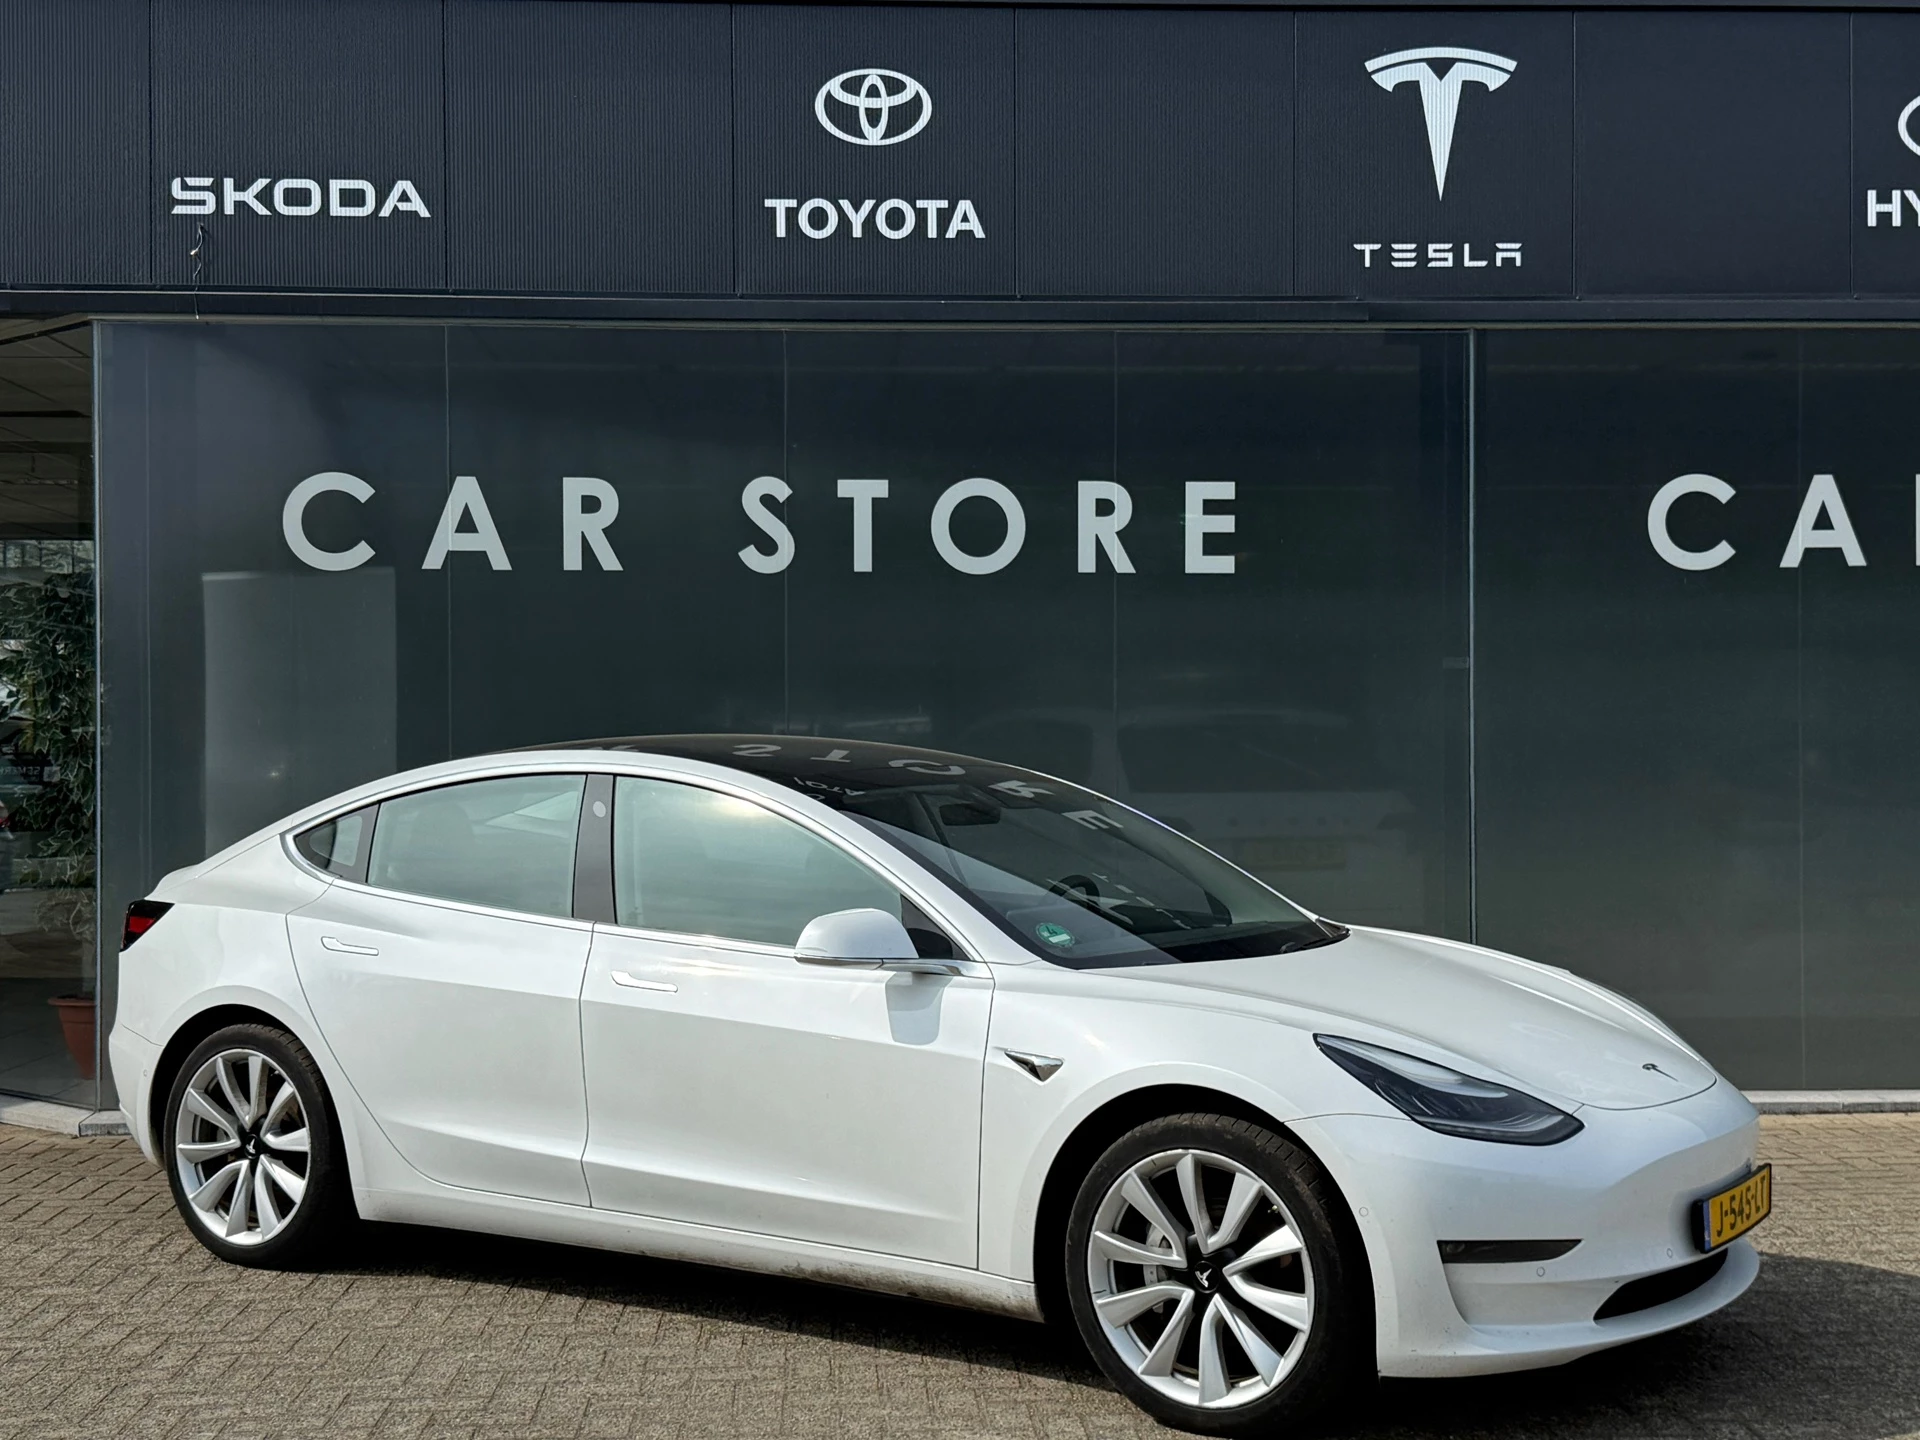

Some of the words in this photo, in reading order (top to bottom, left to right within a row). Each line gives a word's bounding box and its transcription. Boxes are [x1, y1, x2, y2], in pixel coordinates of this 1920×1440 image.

[764, 197, 986, 240] TOYOTA
[1353, 242, 1523, 268] TESLA
[282, 471, 624, 572] CAR
[737, 475, 1237, 575] STORE
[1647, 473, 1920, 571] CA
[1716, 1174, 1766, 1238] J-545-LT
